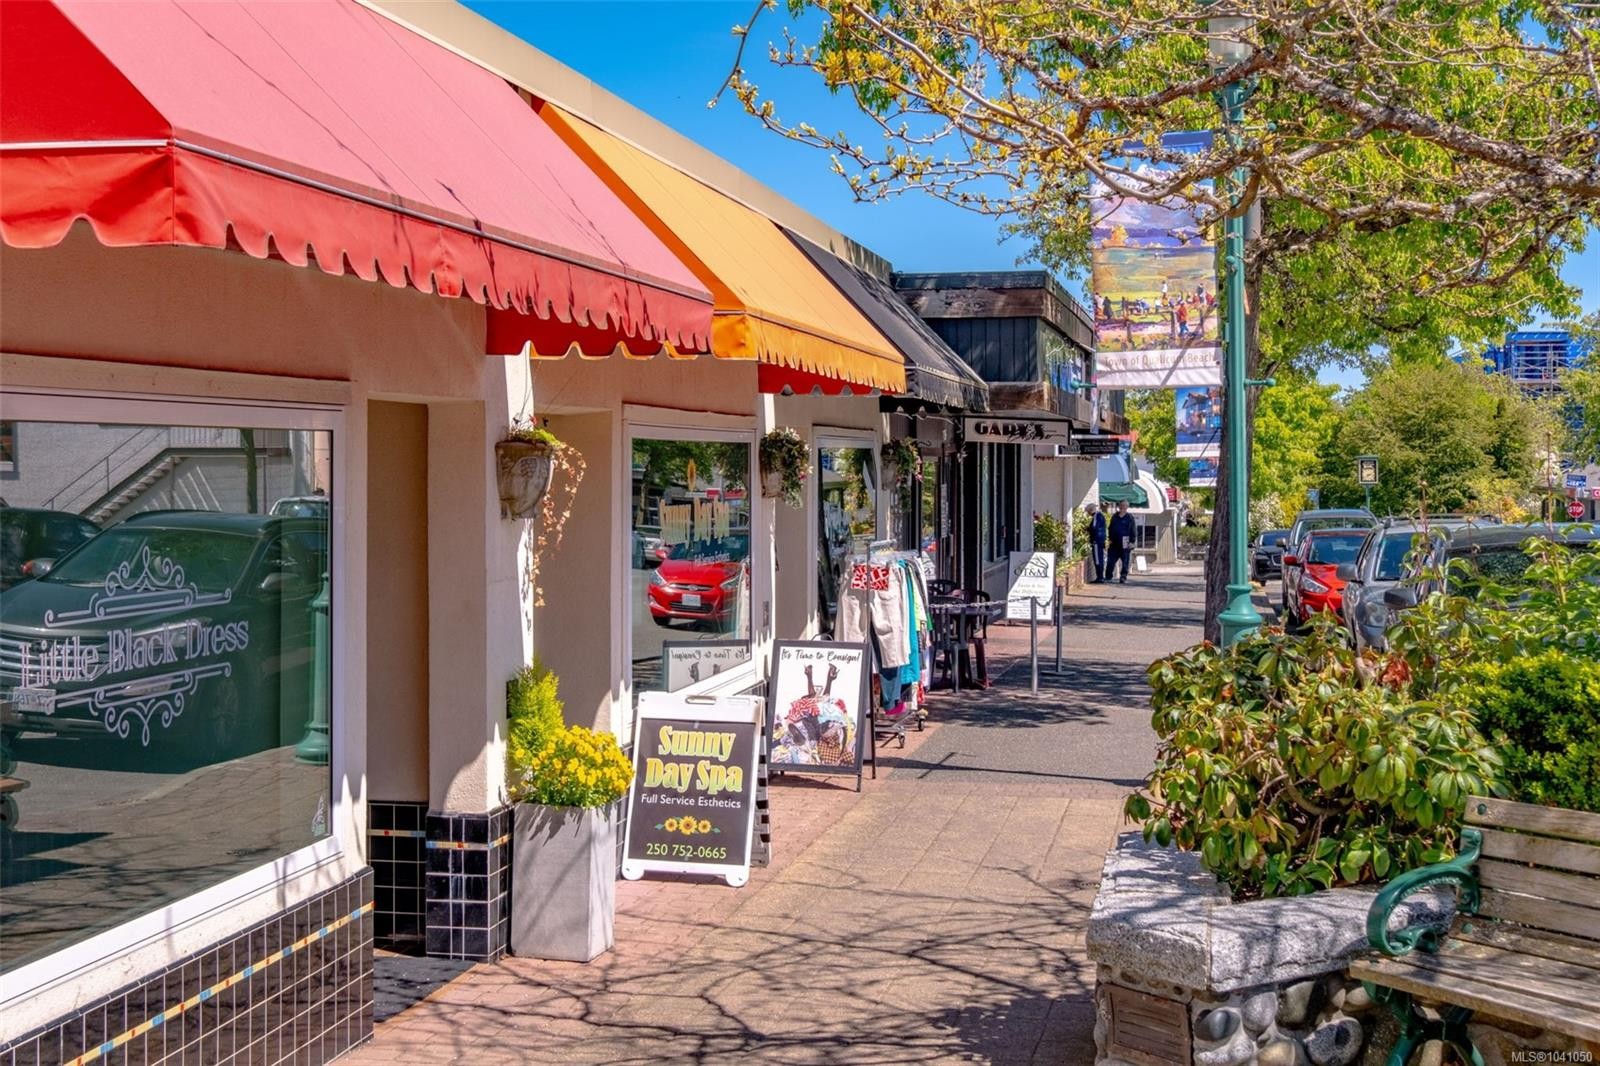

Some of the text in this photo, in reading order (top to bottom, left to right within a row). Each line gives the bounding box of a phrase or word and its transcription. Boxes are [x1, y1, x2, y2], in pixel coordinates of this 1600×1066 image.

[1104, 356, 1127, 366] Town
[1130, 356, 1138, 365] of
[1187, 352, 1214, 363] Beach
[1568, 505, 1583, 514] STOP
[19, 618, 249, 688] Little Black Dress
[781, 648, 861, 664] It's Time to Consign!
[658, 725, 736, 762] Sunny
[644, 757, 743, 794] Day Spa
[641, 794, 741, 809] Full Service Esthetics
[646, 843, 727, 859] 250 752-0665
